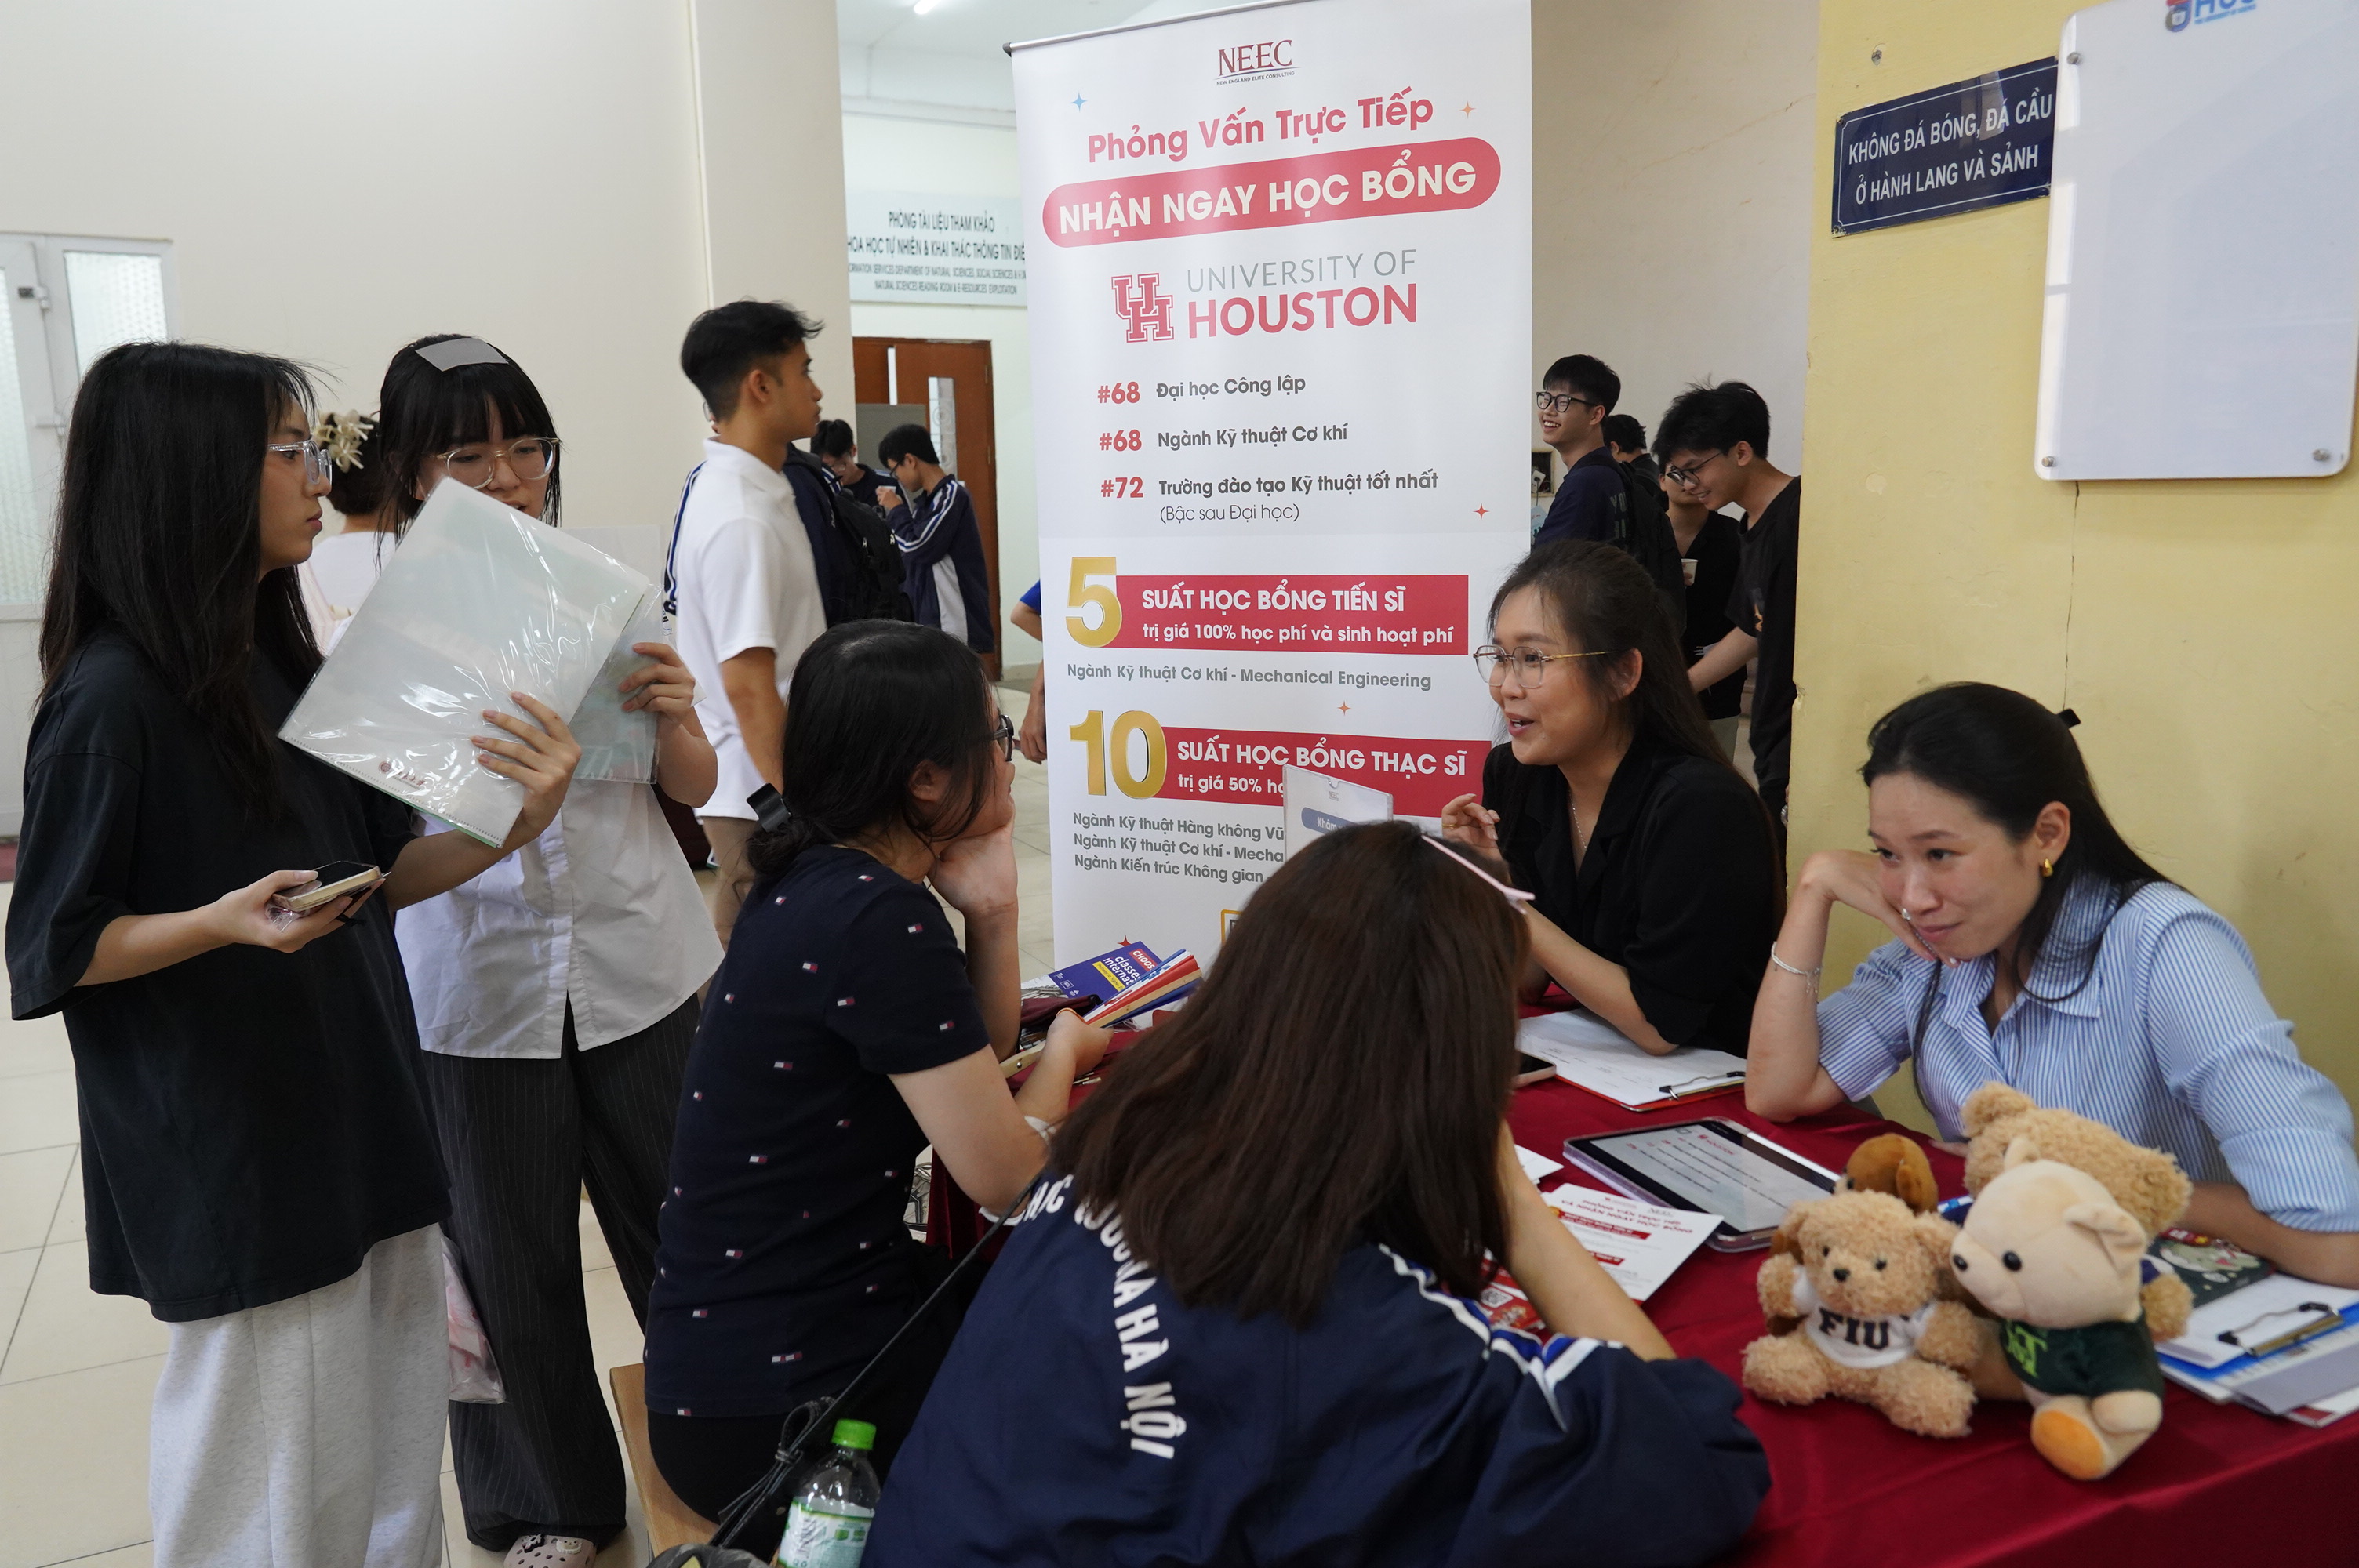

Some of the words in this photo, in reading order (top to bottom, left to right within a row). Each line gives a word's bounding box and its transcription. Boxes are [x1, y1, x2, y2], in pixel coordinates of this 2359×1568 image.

[1218, 39, 1293, 77] NEEC
[1265, 71, 1296, 80] CONSULTING
[1088, 124, 1188, 163] Phỏng
[1198, 107, 1264, 149] Vấn
[1275, 105, 1347, 144] Trực
[1358, 85, 1434, 131] Tiếp
[1848, 132, 1899, 165] KHÔNG
[1904, 120, 1925, 151] ĐÁ
[1931, 112, 1980, 144] BÓNG,
[1986, 98, 2009, 132] ĐÁ
[2016, 87, 2053, 125] CẦU
[1856, 174, 1866, 205] Ở
[1870, 171, 1911, 202] HÀNH
[1916, 163, 1958, 193] LANG
[1964, 150, 1985, 182] VÀ
[1990, 142, 2039, 176] SẢNH
[1060, 191, 1151, 238] NHẬN
[1163, 183, 1257, 225] NGAY
[1268, 173, 1349, 218] HỌC
[1361, 149, 1477, 202] BỔNG
[1187, 253, 1364, 292] UNIVERSITY
[1373, 249, 1416, 276] OF
[1188, 283, 1417, 339] HOUSTON
[1098, 381, 1140, 405] #68
[1156, 382, 1184, 401] Đại
[1189, 381, 1219, 400] học
[1224, 376, 1272, 397] Công
[1277, 374, 1307, 395] lập
[1099, 429, 1142, 452] #68
[1158, 430, 1212, 451] Ngành
[1216, 428, 1237, 448] Kỹ
[1241, 426, 1288, 447] thuật
[1292, 426, 1318, 442] Cơ
[1323, 422, 1349, 441] khí
[1100, 477, 1144, 499] #72
[1158, 478, 1213, 499] Trường
[1217, 477, 1252, 494] đào
[1256, 477, 1287, 497] tạo
[1292, 475, 1313, 495] Kỹ
[1318, 474, 1362, 495] thuật
[1366, 470, 1390, 490] tốt
[1395, 468, 1438, 488] nhất
[1160, 505, 1195, 524] (Bậc
[1198, 508, 1226, 521] sau
[1229, 504, 1256, 523] Đại
[1260, 503, 1299, 522] học)
[1065, 556, 1122, 648] 5
[1142, 580, 1194, 609] SUẤT
[1200, 590, 1252, 615] HỌC
[1257, 579, 1327, 611] BỔNG
[1332, 581, 1378, 611] TIẾN
[1384, 586, 1406, 612] SĨ
[1143, 623, 1159, 642] trị
[1163, 622, 1189, 642] giá
[1194, 624, 1237, 640] 100%
[1241, 625, 1274, 644] học
[1279, 623, 1307, 644] phí
[1311, 624, 1332, 641] và
[1338, 626, 1372, 641] sinh
[1376, 627, 1418, 647] hoạt
[1423, 626, 1454, 646] phí
[1067, 663, 1112, 681] Ngành
[1117, 665, 1134, 681] Kỹ
[1139, 665, 1176, 683] thuật
[1180, 666, 1201, 681] Cơ
[1206, 666, 1227, 681] khí
[1241, 668, 1333, 684] Mechanical
[1338, 670, 1432, 691] Engineering
[1069, 710, 1168, 800] 10
[1177, 734, 1230, 763] SUẤT
[1236, 744, 1289, 770] HỌC
[1296, 736, 1365, 770] BỔNG
[1371, 750, 1438, 779] THẠC
[1444, 750, 1468, 775] SĨ
[1178, 774, 1194, 792] trị
[1198, 775, 1223, 793] giá
[1229, 777, 1262, 793] 50%
[1073, 812, 1115, 829] Ngành
[1119, 816, 1136, 831] Kỹ
[1139, 817, 1174, 834] thuật
[1177, 819, 1214, 838] Hàng
[1217, 823, 1261, 841] không
[1265, 826, 1285, 840] Vũ
[1074, 833, 1116, 850] Ngành
[1120, 837, 1137, 852] Kỹ
[1140, 838, 1176, 855] thuật
[1179, 840, 1199, 855] Cơ
[1203, 843, 1223, 858] khí
[1074, 854, 1117, 870] Ngành
[1121, 857, 1150, 873] Kiến
[1154, 861, 1180, 876] trúc
[1184, 864, 1228, 883] Không
[1232, 869, 1263, 884] gian
[1132, 950, 1156, 971] CHOOS
[1114, 1303, 1169, 1373] HÀ
[1819, 1307, 1889, 1351] FIU
[1120, 1381, 1187, 1460] NỘI
